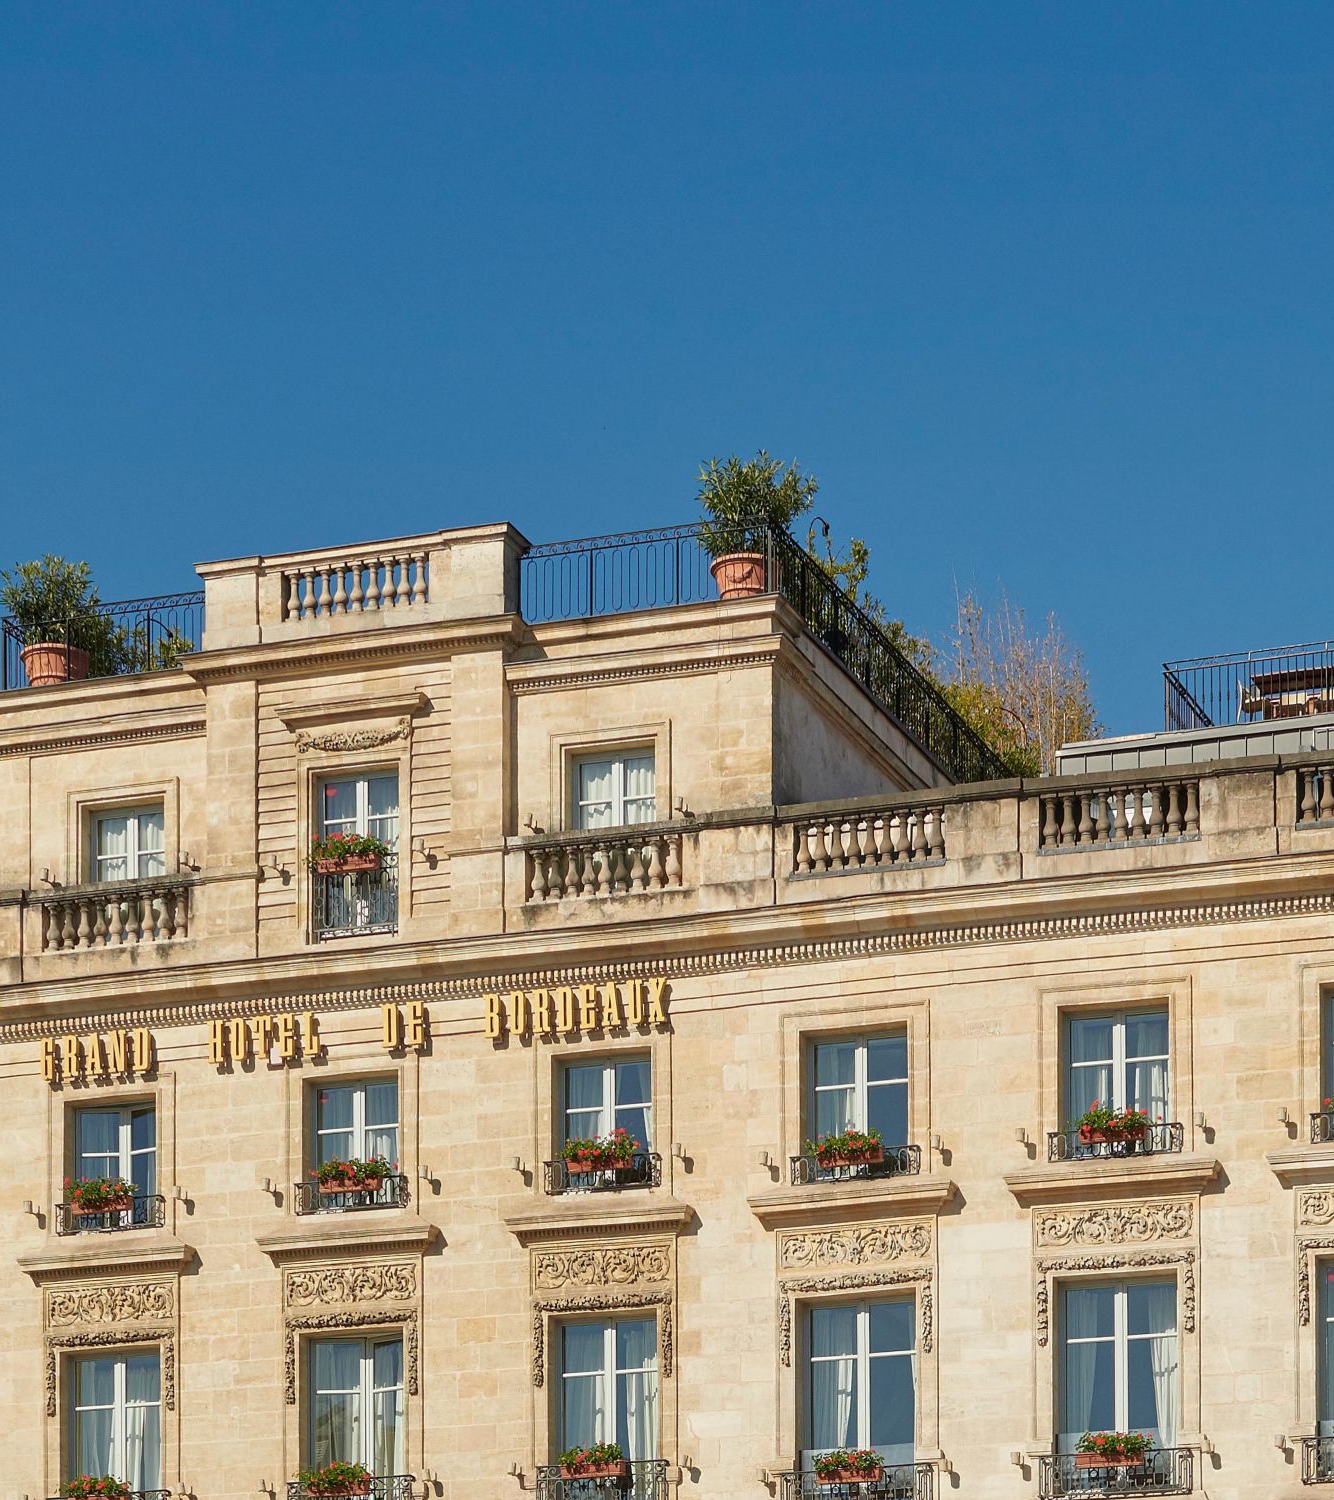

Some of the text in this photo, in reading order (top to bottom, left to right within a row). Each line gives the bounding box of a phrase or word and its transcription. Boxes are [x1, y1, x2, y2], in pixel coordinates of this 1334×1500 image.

[40, 977, 667, 1081] GRAND HOTEL DE BORDEAUX
